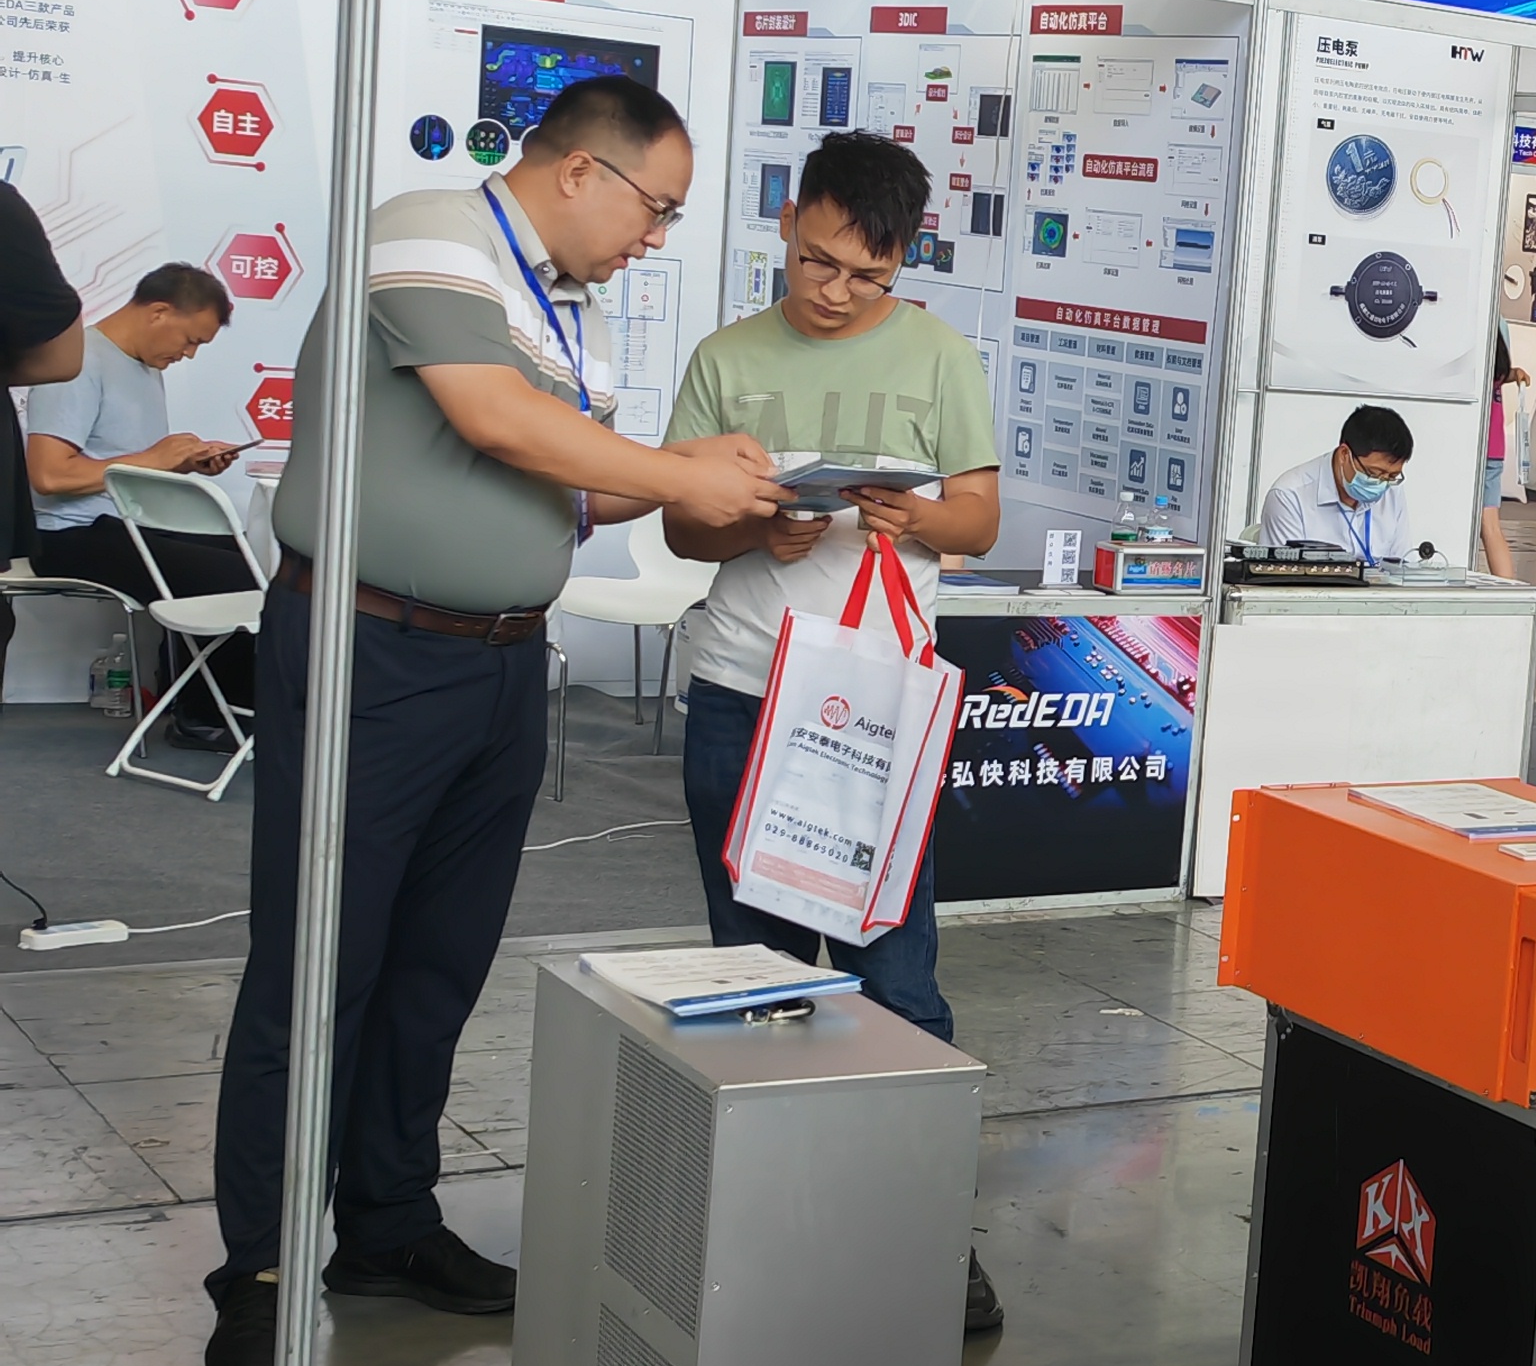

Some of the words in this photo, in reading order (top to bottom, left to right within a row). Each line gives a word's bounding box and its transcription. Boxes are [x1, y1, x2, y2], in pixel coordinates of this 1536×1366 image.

[898, 12, 919, 28] 3DIC
[1039, 11, 1108, 32] 自动化仿真平台
[1316, 36, 1359, 58] 压电泵
[212, 108, 262, 137] 自主
[1085, 158, 1155, 178] 自动化仿真平台流程
[229, 254, 280, 281] 可控
[1055, 306, 1161, 335] 自动化仿真平台数据管理
[957, 691, 1116, 730] RedEDA
[941, 755, 1168, 789] 弘快科技有限公司
[1349, 1293, 1397, 1337] Triumph
[1401, 1322, 1432, 1356] Load
